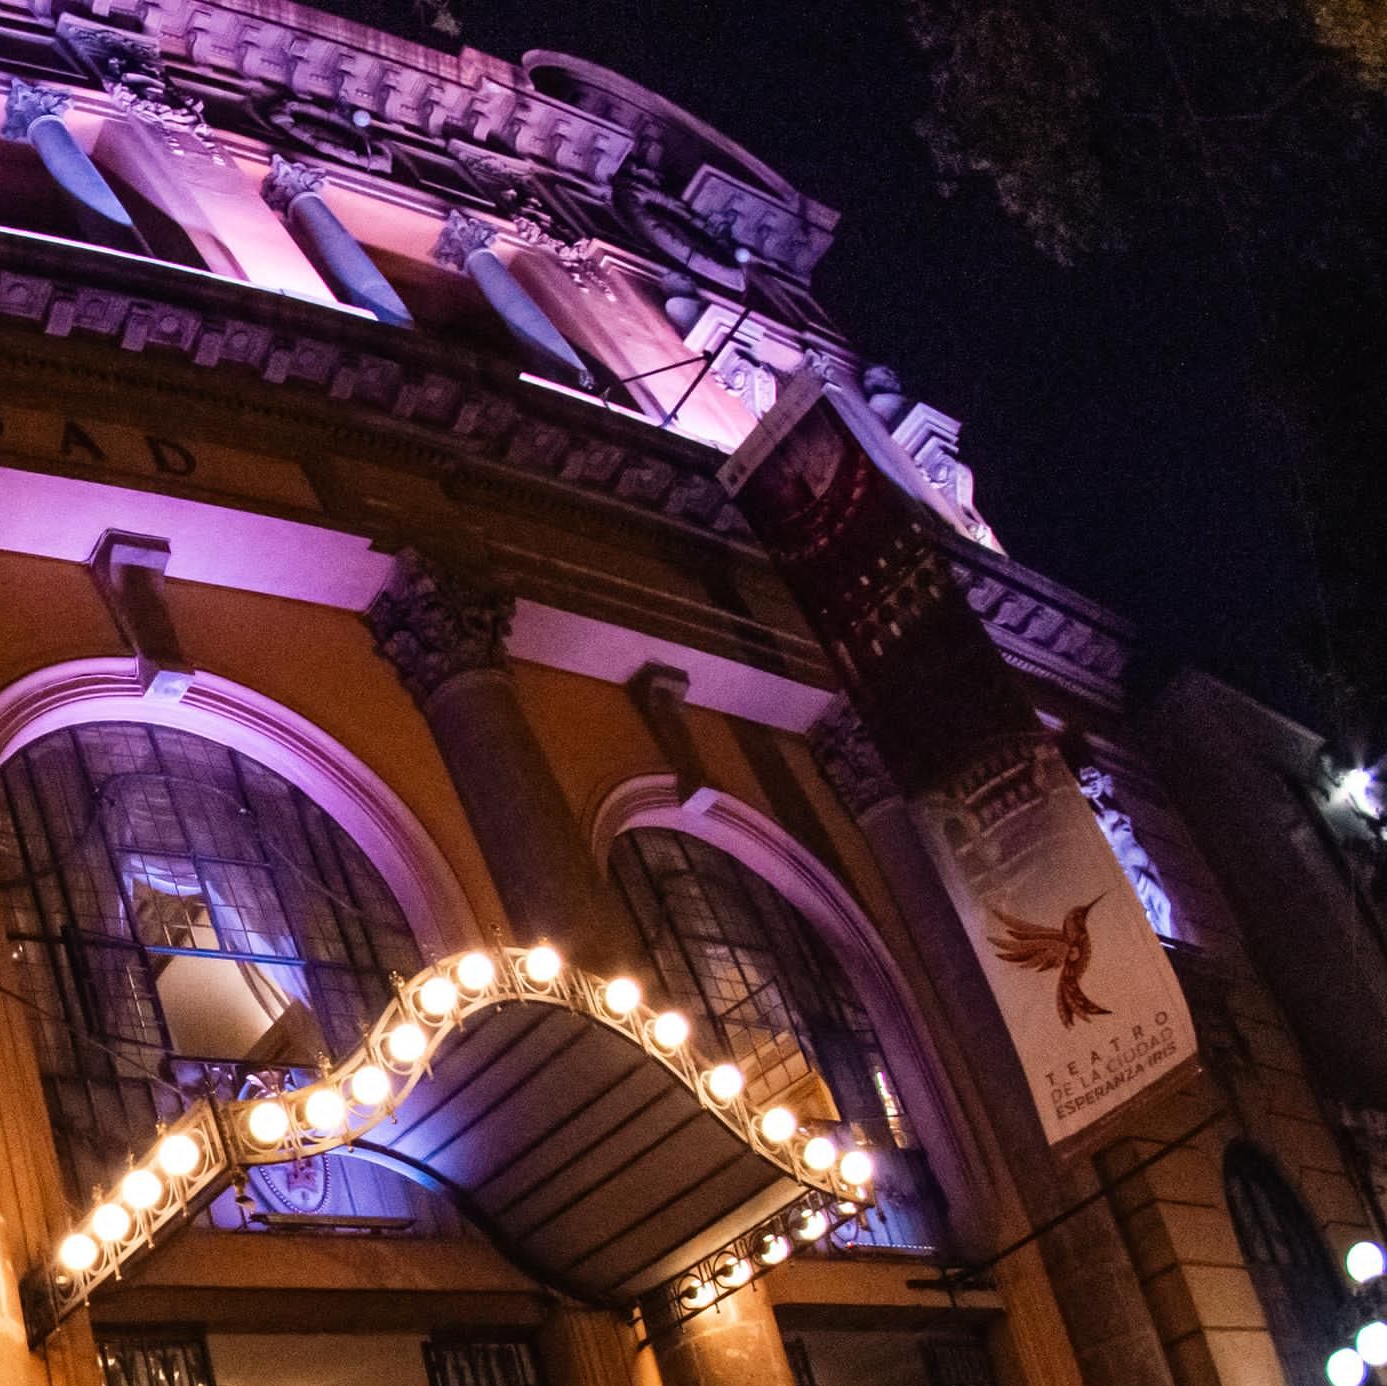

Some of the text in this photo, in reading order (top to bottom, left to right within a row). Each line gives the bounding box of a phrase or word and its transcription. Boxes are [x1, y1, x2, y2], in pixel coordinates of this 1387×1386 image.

[1045, 1011, 1168, 1086] TEATRO
[1051, 1027, 1173, 1104] DE LA CIUDAD
[1056, 1041, 1177, 1119] ESPERANZA IRIS
